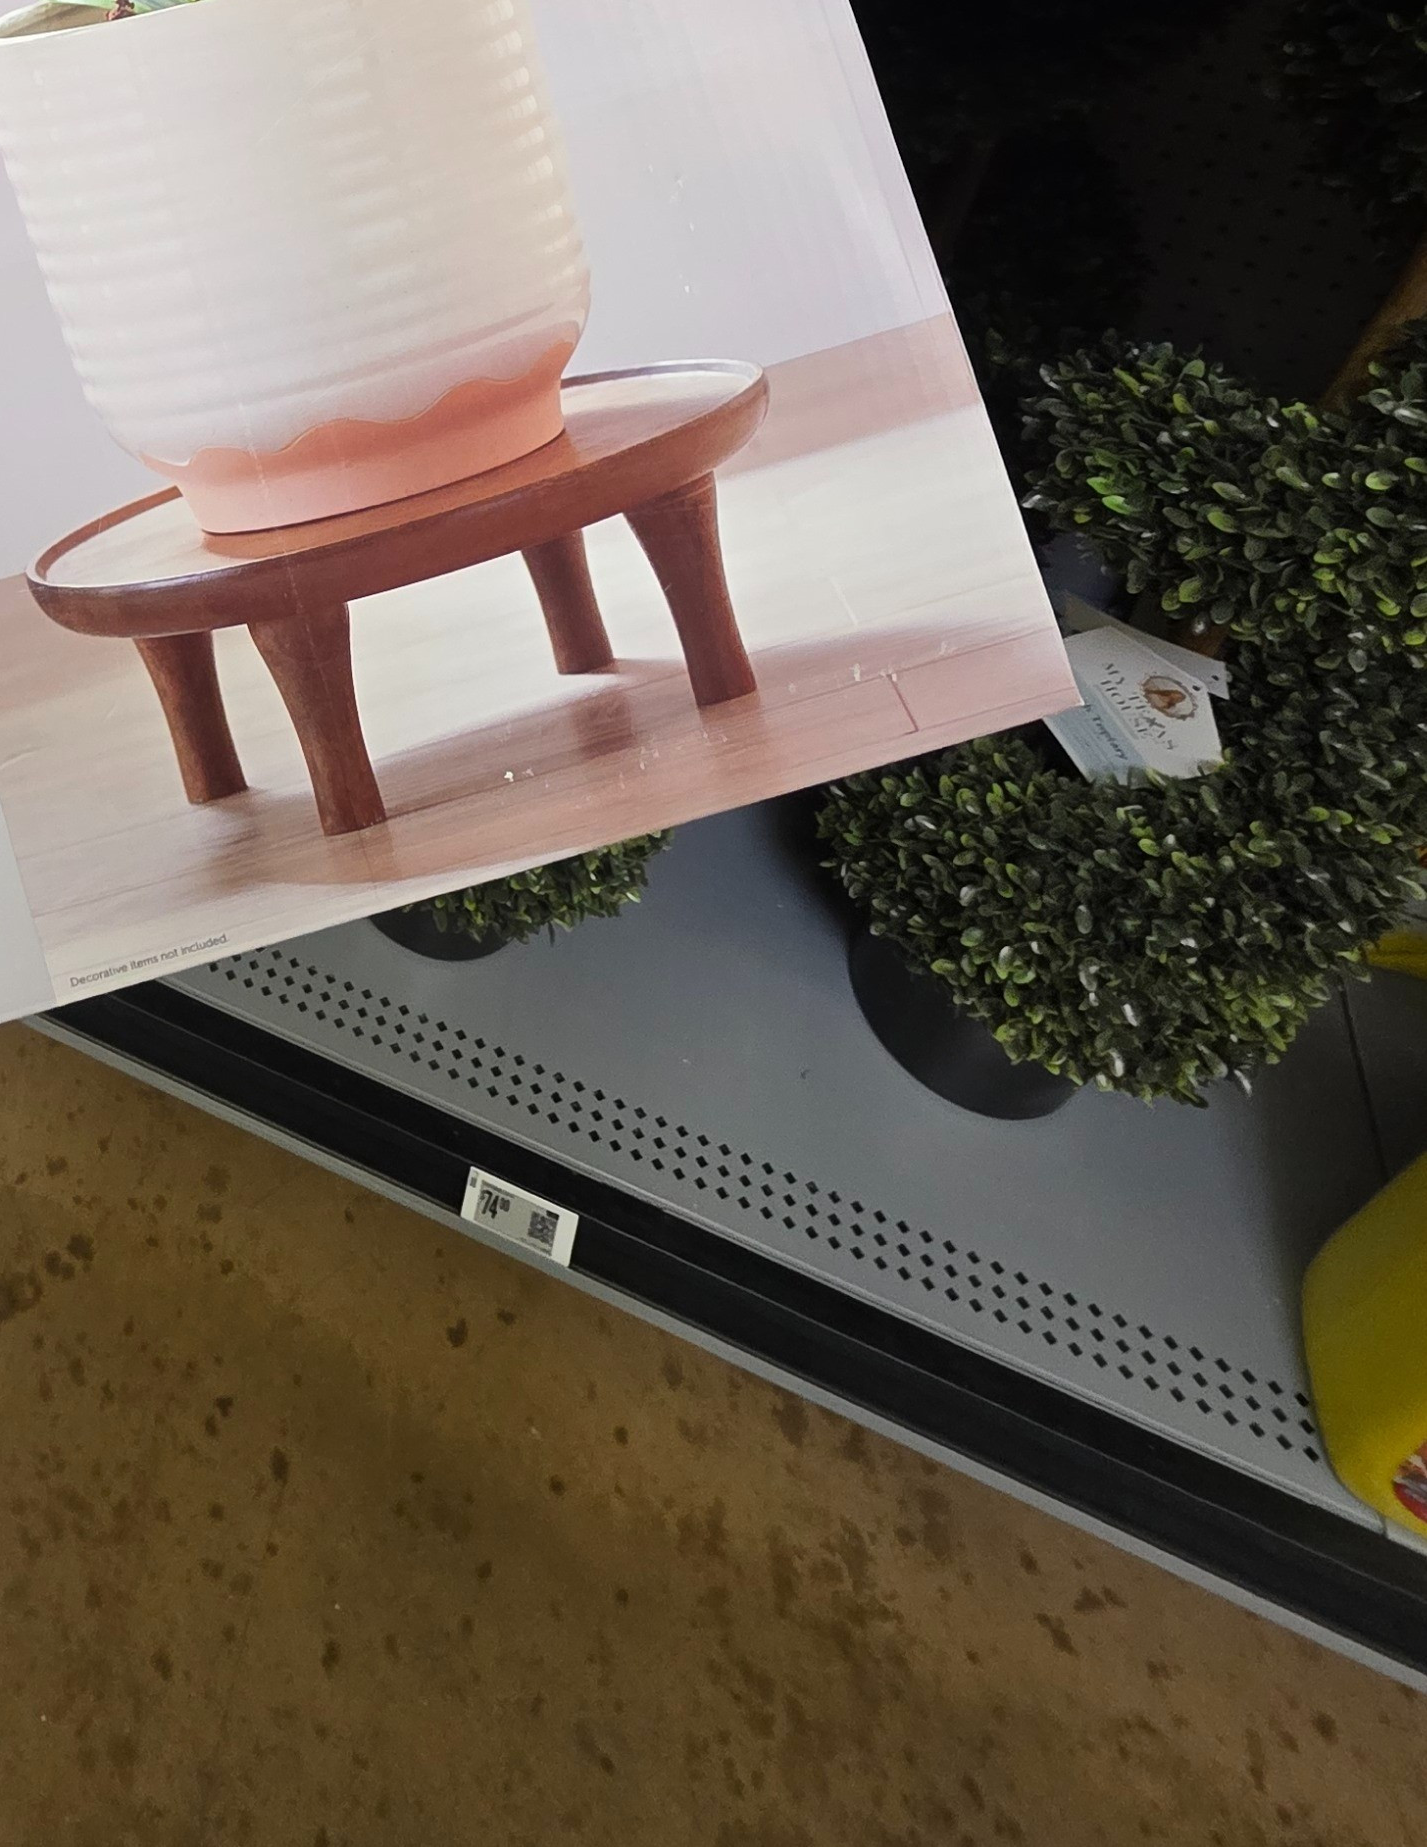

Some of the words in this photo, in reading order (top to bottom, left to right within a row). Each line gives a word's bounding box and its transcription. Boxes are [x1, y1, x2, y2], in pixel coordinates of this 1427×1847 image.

[69, 964, 129, 988] Decorative
[129, 955, 159, 971] items
[160, 949, 179, 961] not
